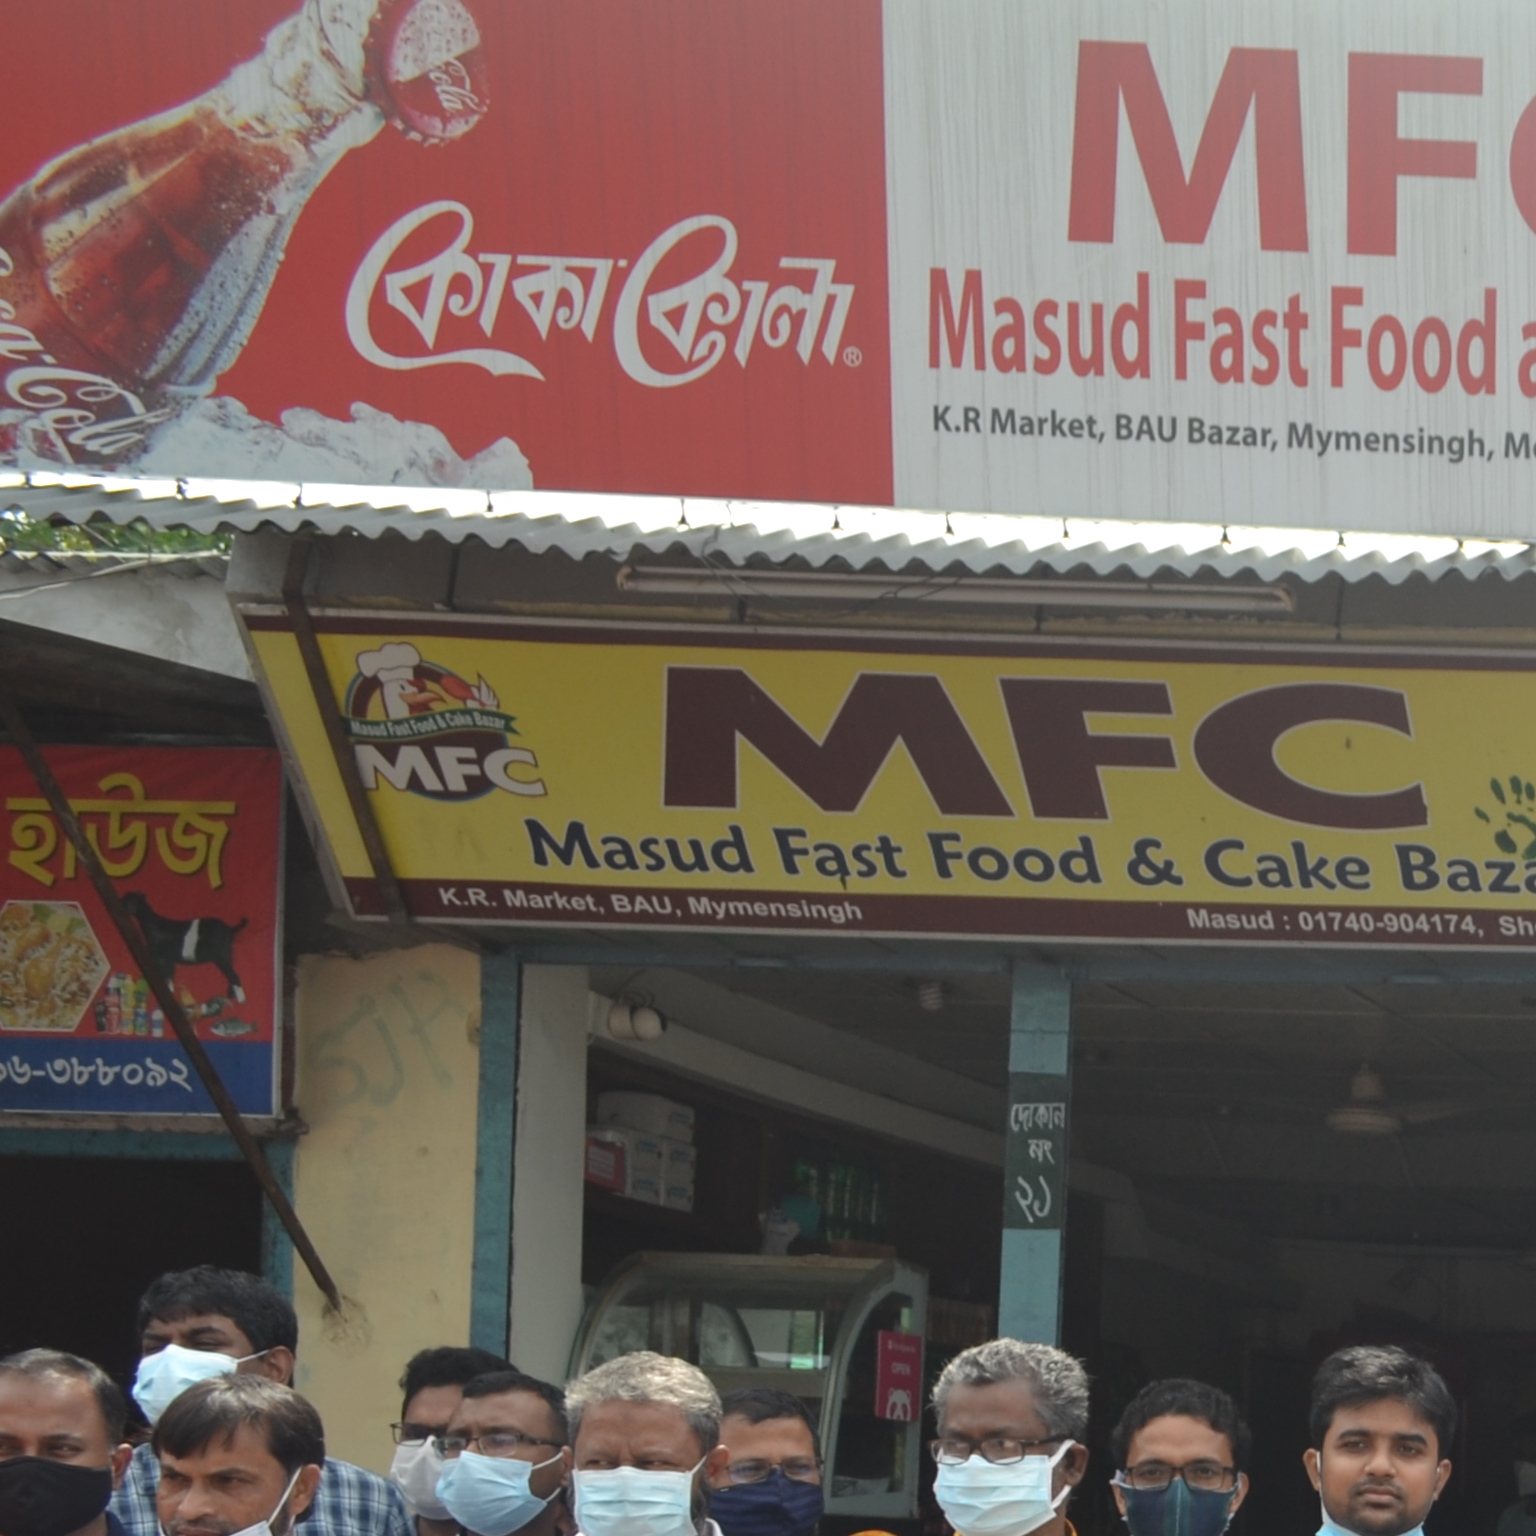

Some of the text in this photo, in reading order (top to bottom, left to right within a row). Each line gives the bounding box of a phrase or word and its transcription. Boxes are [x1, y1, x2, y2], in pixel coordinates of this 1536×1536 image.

[928, 267, 1151, 380] Masud
[1173, 278, 1309, 388] Fast
[1329, 285, 1498, 397] Food
[932, 406, 982, 435] K.R
[989, 410, 1105, 444] Market,
[1114, 413, 1178, 446] BAU
[1187, 417, 1279, 454] Bazar,
[1287, 421, 1496, 466] Mymensingh,
[351, 720, 387, 737] Masud
[389, 720, 409, 737] Fast
[411, 714, 437, 735] Food
[448, 711, 473, 727] Cake
[475, 711, 505, 729] Bazar
[662, 665, 1432, 830] MFC
[353, 744, 548, 797] MFC
[525, 818, 756, 877] Masud
[773, 826, 909, 881] Fast
[926, 831, 1103, 886] Food
[1126, 838, 1184, 888] &
[1203, 839, 1373, 893] Cake
[439, 887, 863, 923] K.R. Market, BAU, Mymensingh
[1187, 908, 1276, 932] Masud
[1298, 908, 1485, 940] 01740-904174,
[1028, 1140, 1055, 1165] নং
[1015, 1176, 1051, 1223] ২১
